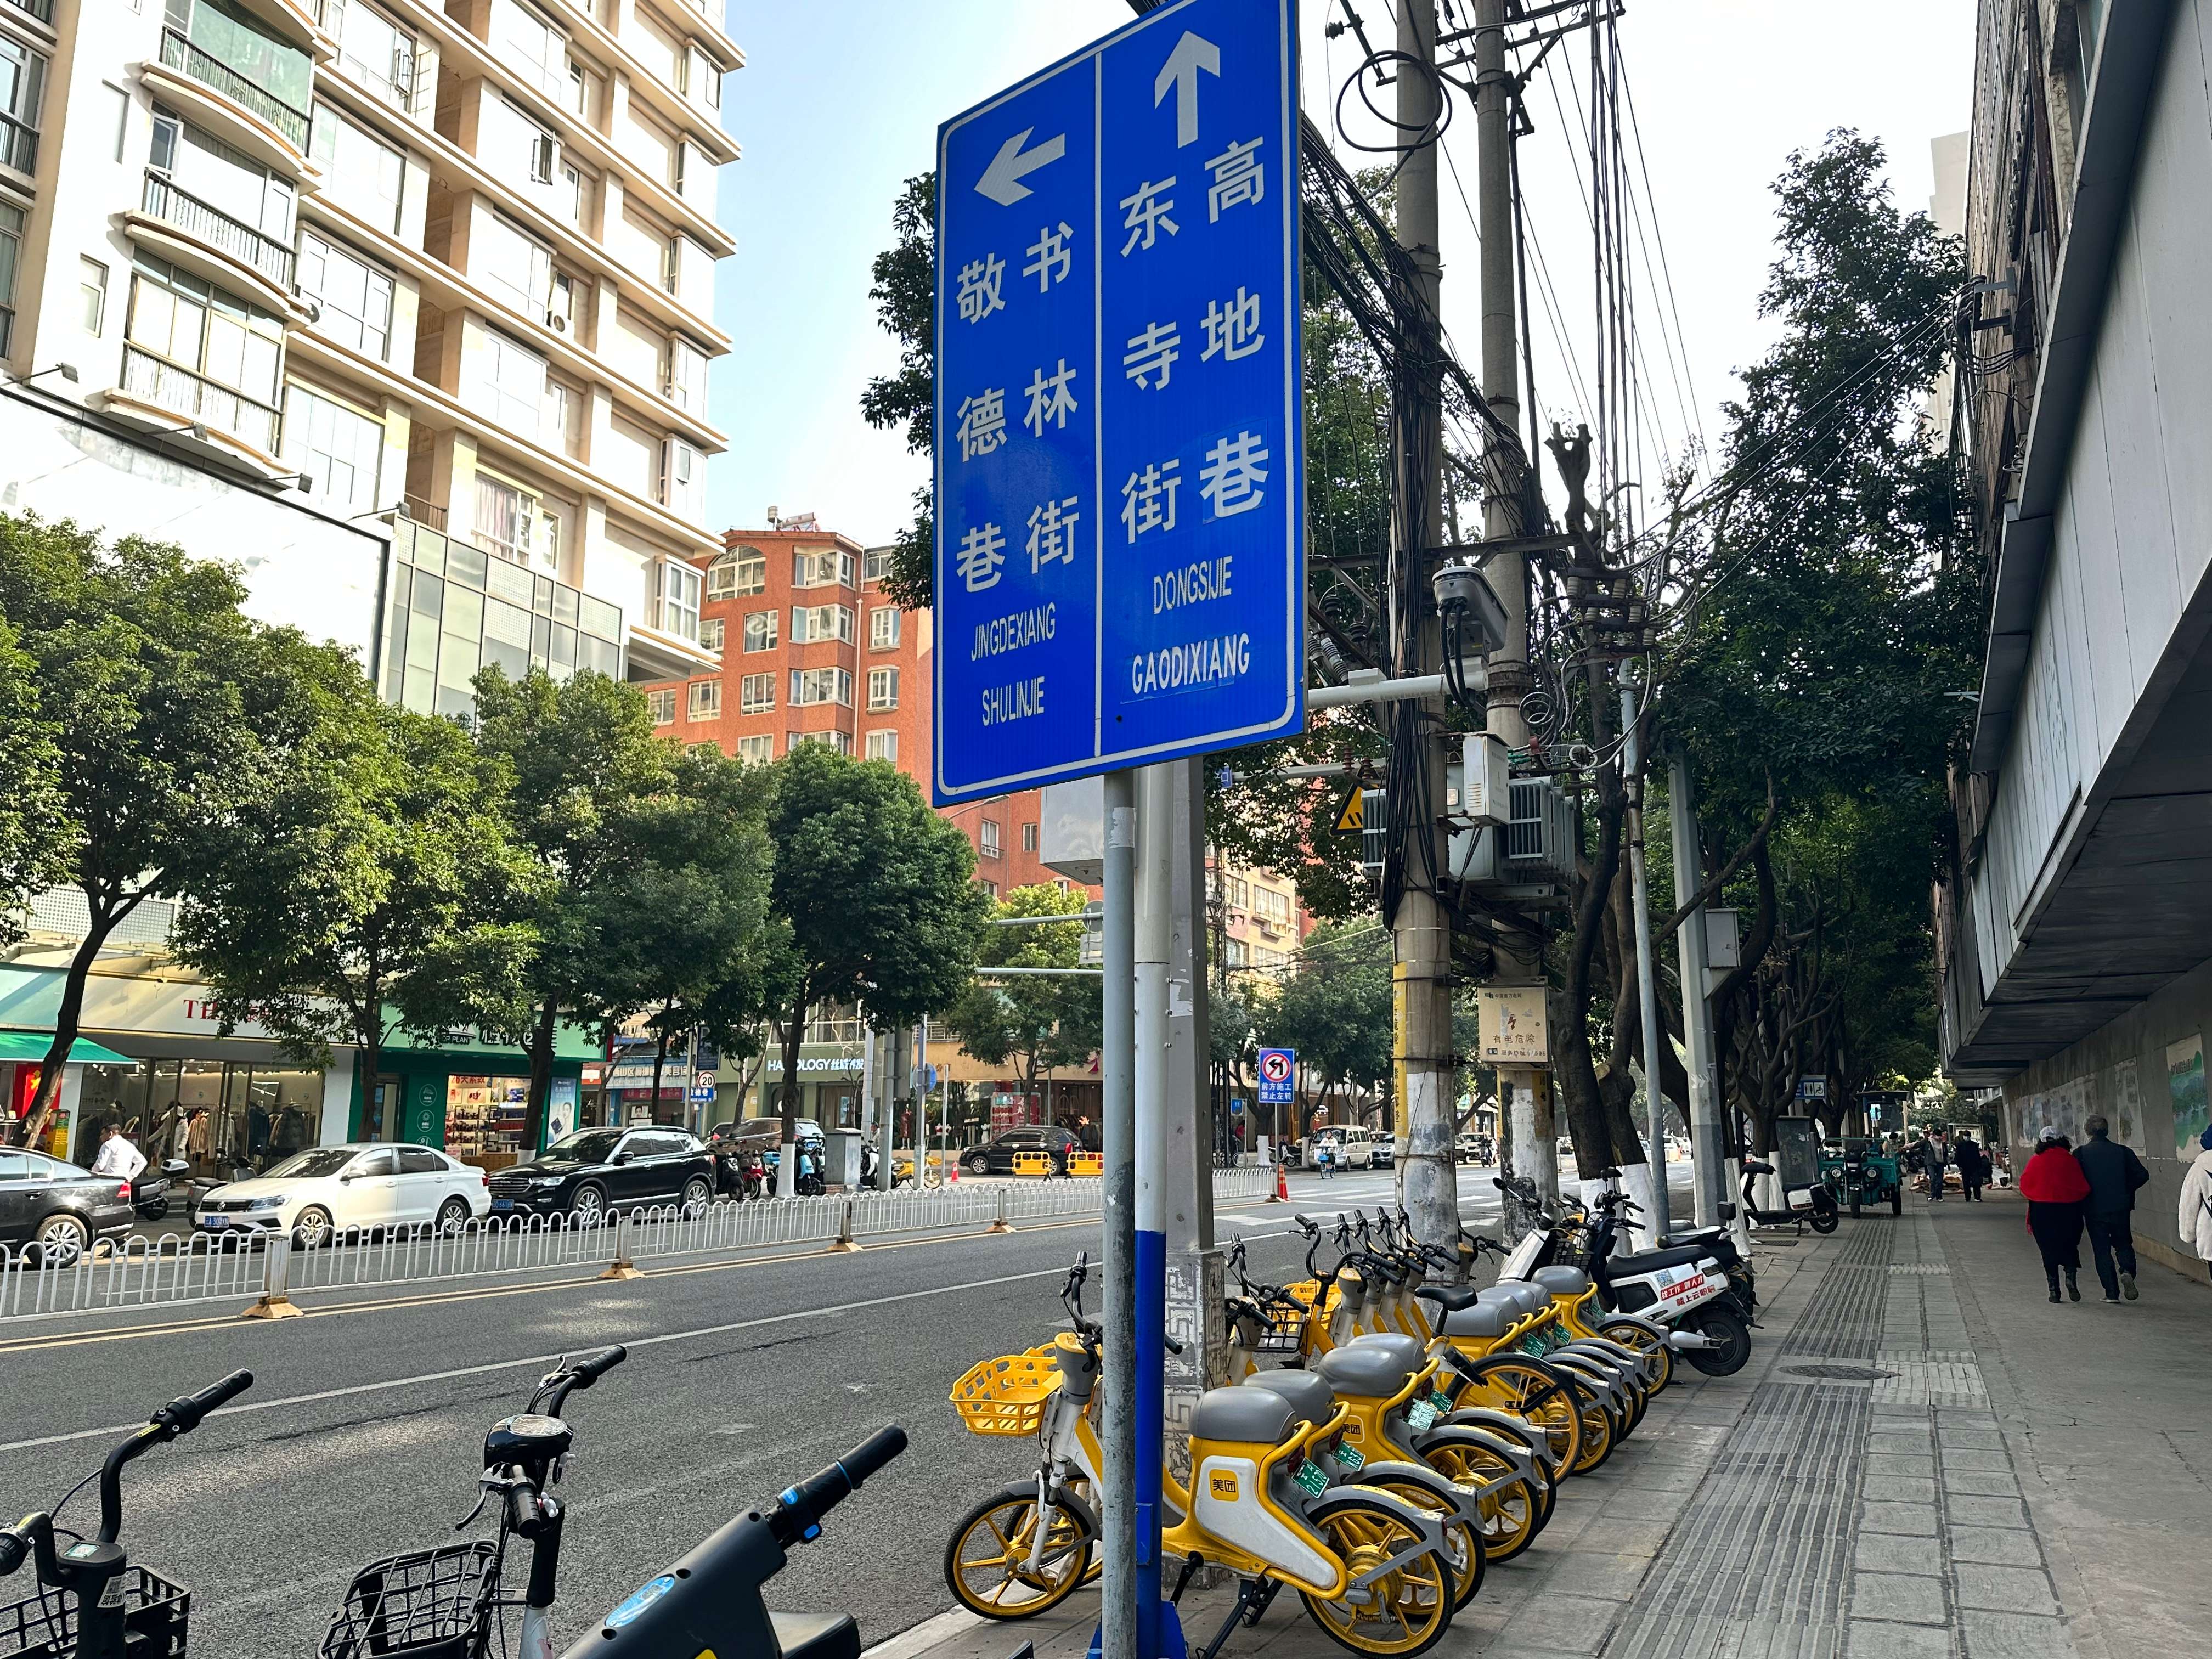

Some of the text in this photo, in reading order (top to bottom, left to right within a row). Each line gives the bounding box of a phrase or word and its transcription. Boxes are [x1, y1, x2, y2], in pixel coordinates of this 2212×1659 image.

[1200, 136, 1269, 517] 高地巷
[1120, 176, 1181, 544] 东寺街
[956, 253, 1007, 593] 敬德巷
[1023, 221, 1080, 575] 书林街
[1154, 555, 1233, 614] DONGSIJIE
[970, 601, 1056, 661] JINGDEXIANG
[1132, 632, 1250, 695] GAODIXIANG
[982, 676, 1045, 727] SHULINJIE
[1492, 1034, 1536, 1044] 有电危险
[702, 1076, 713, 1086] 20
[1261, 1082, 1292, 1091] 前方施工
[1261, 1091, 1292, 1101] 禁止左转
[1212, 1479, 1237, 1493] 美团
